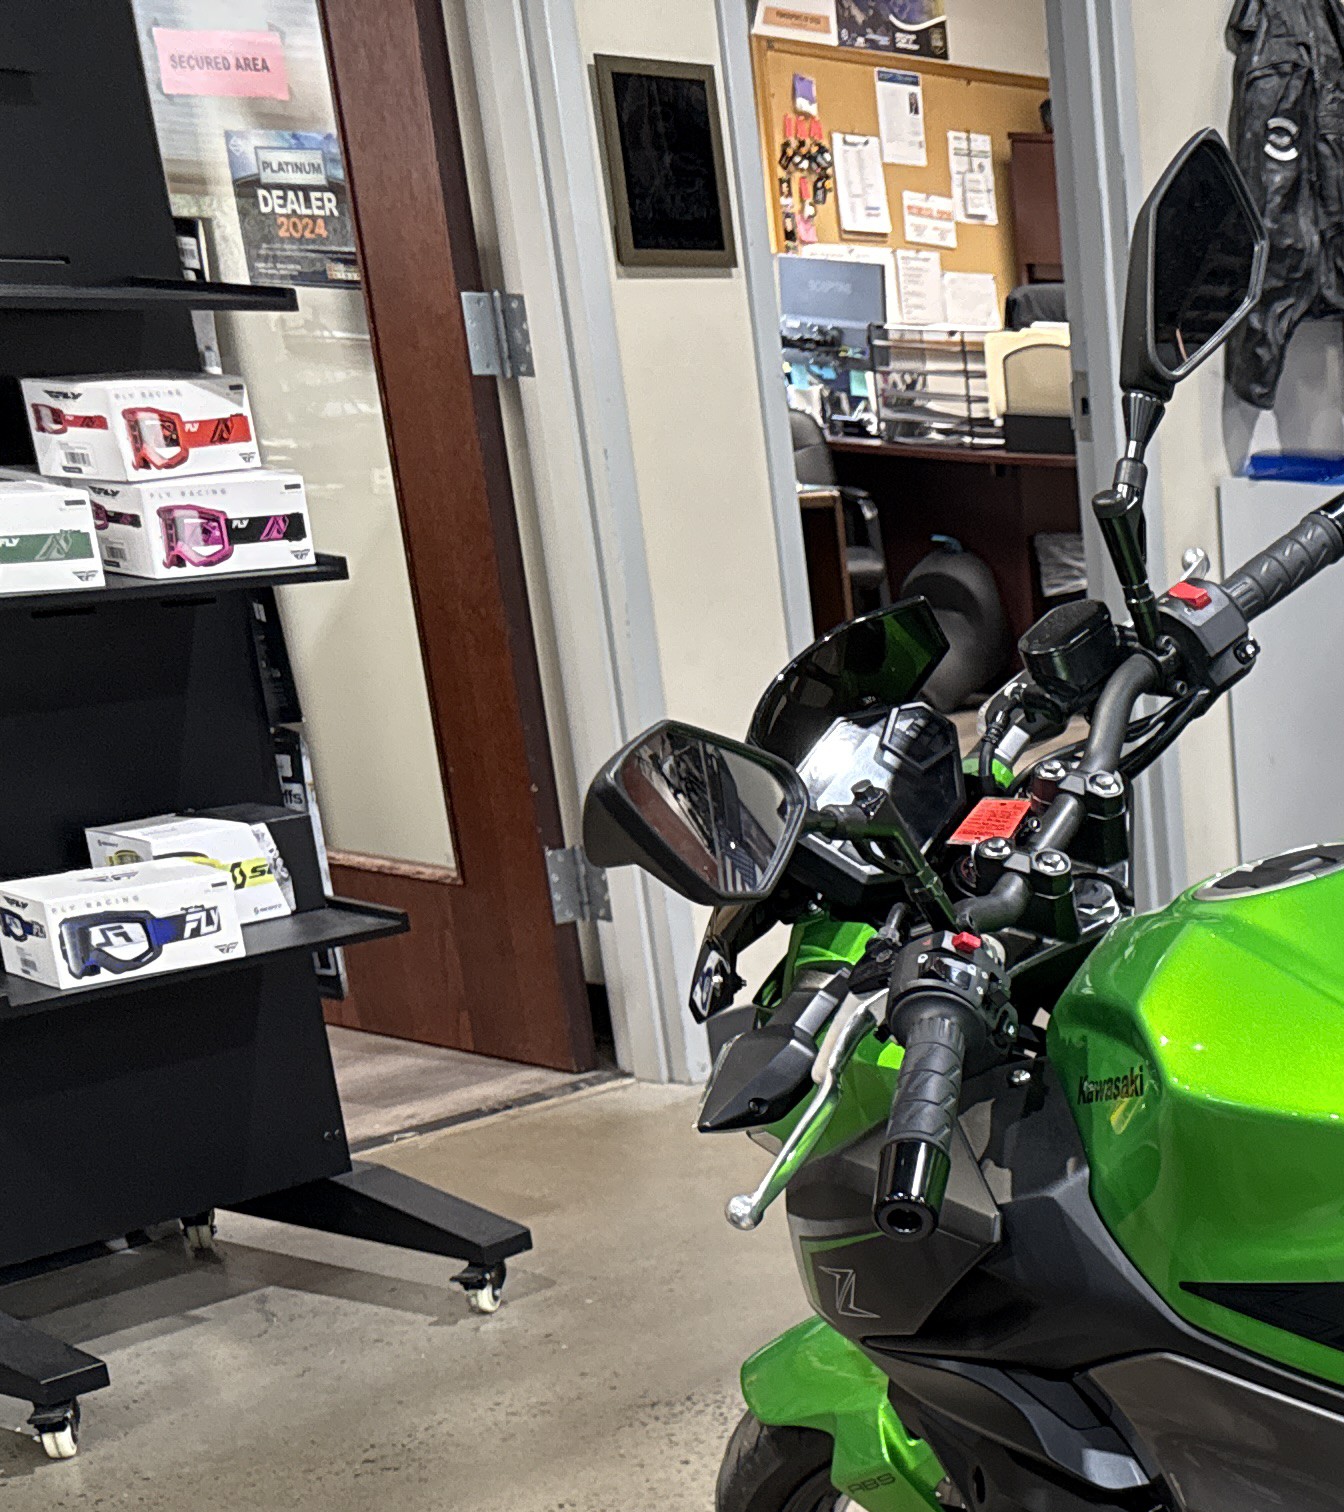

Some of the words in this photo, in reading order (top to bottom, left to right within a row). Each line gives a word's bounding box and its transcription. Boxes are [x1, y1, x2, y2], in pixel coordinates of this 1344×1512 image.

[169, 54, 231, 72] SECURED
[235, 57, 271, 73] AREA
[261, 160, 323, 176] PLATINUM
[256, 188, 340, 217] DEALER
[275, 216, 329, 239] 2024
[231, 518, 250, 529] FLY
[184, 906, 222, 939] FLY
[1077, 1064, 1144, 1105] Kawasaki
[847, 1471, 897, 1496] ABS
